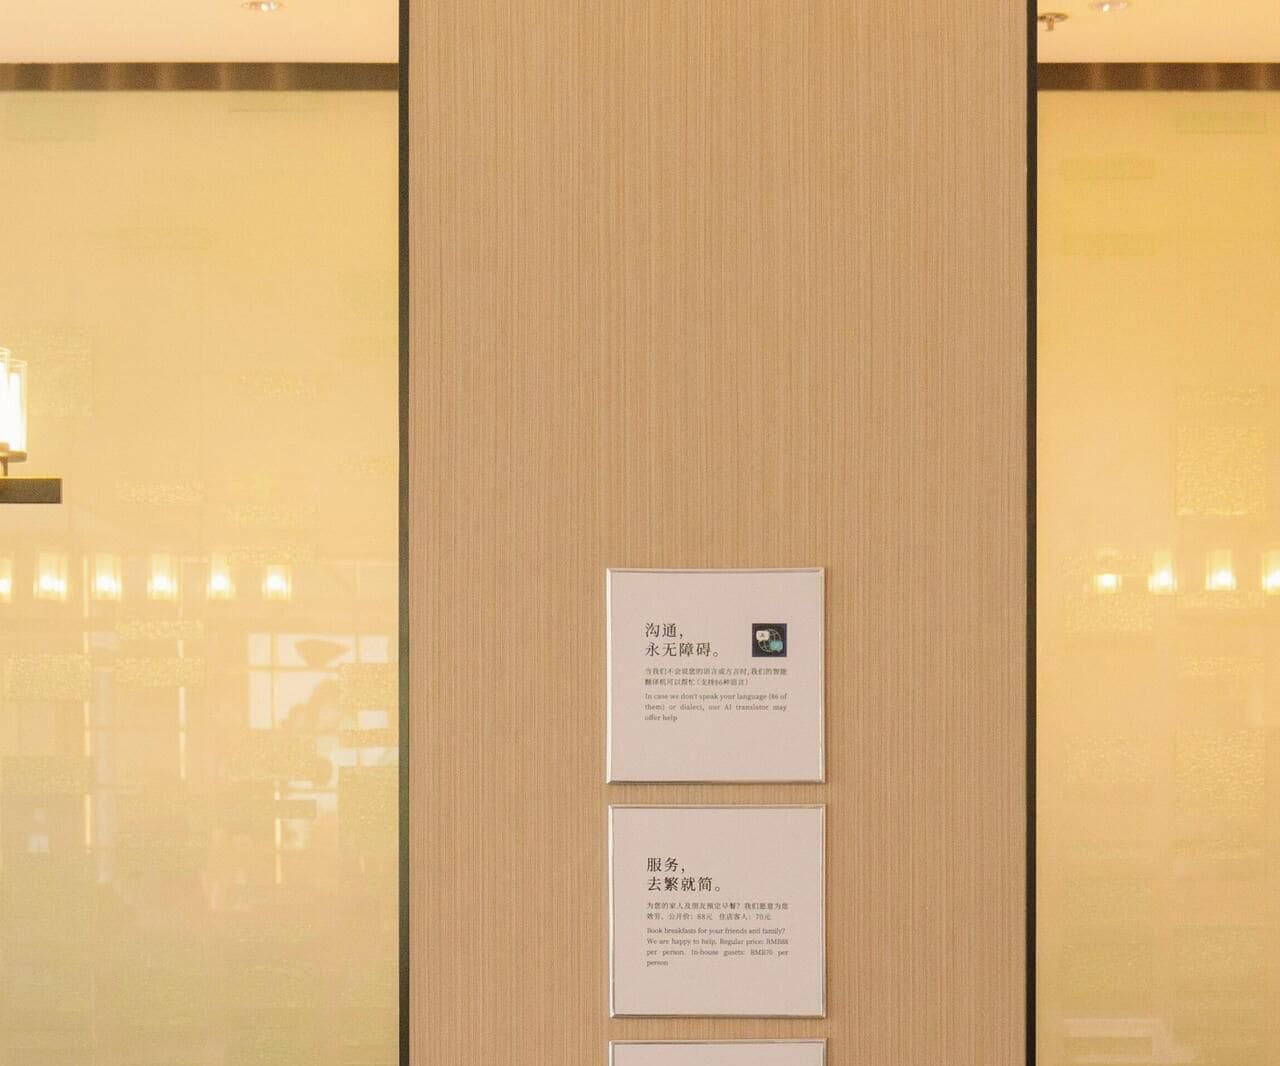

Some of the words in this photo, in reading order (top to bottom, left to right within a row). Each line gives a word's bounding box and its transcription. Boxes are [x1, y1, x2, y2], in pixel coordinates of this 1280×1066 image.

[645, 622, 684, 640] 沟通，
[645, 641, 719, 658] 永无障碍。
[662, 714, 678, 722] help
[646, 857, 686, 874] 服务，
[647, 876, 721, 892] 去繁就简。
[671, 938, 691, 946] happy
[719, 938, 743, 946] Regular
